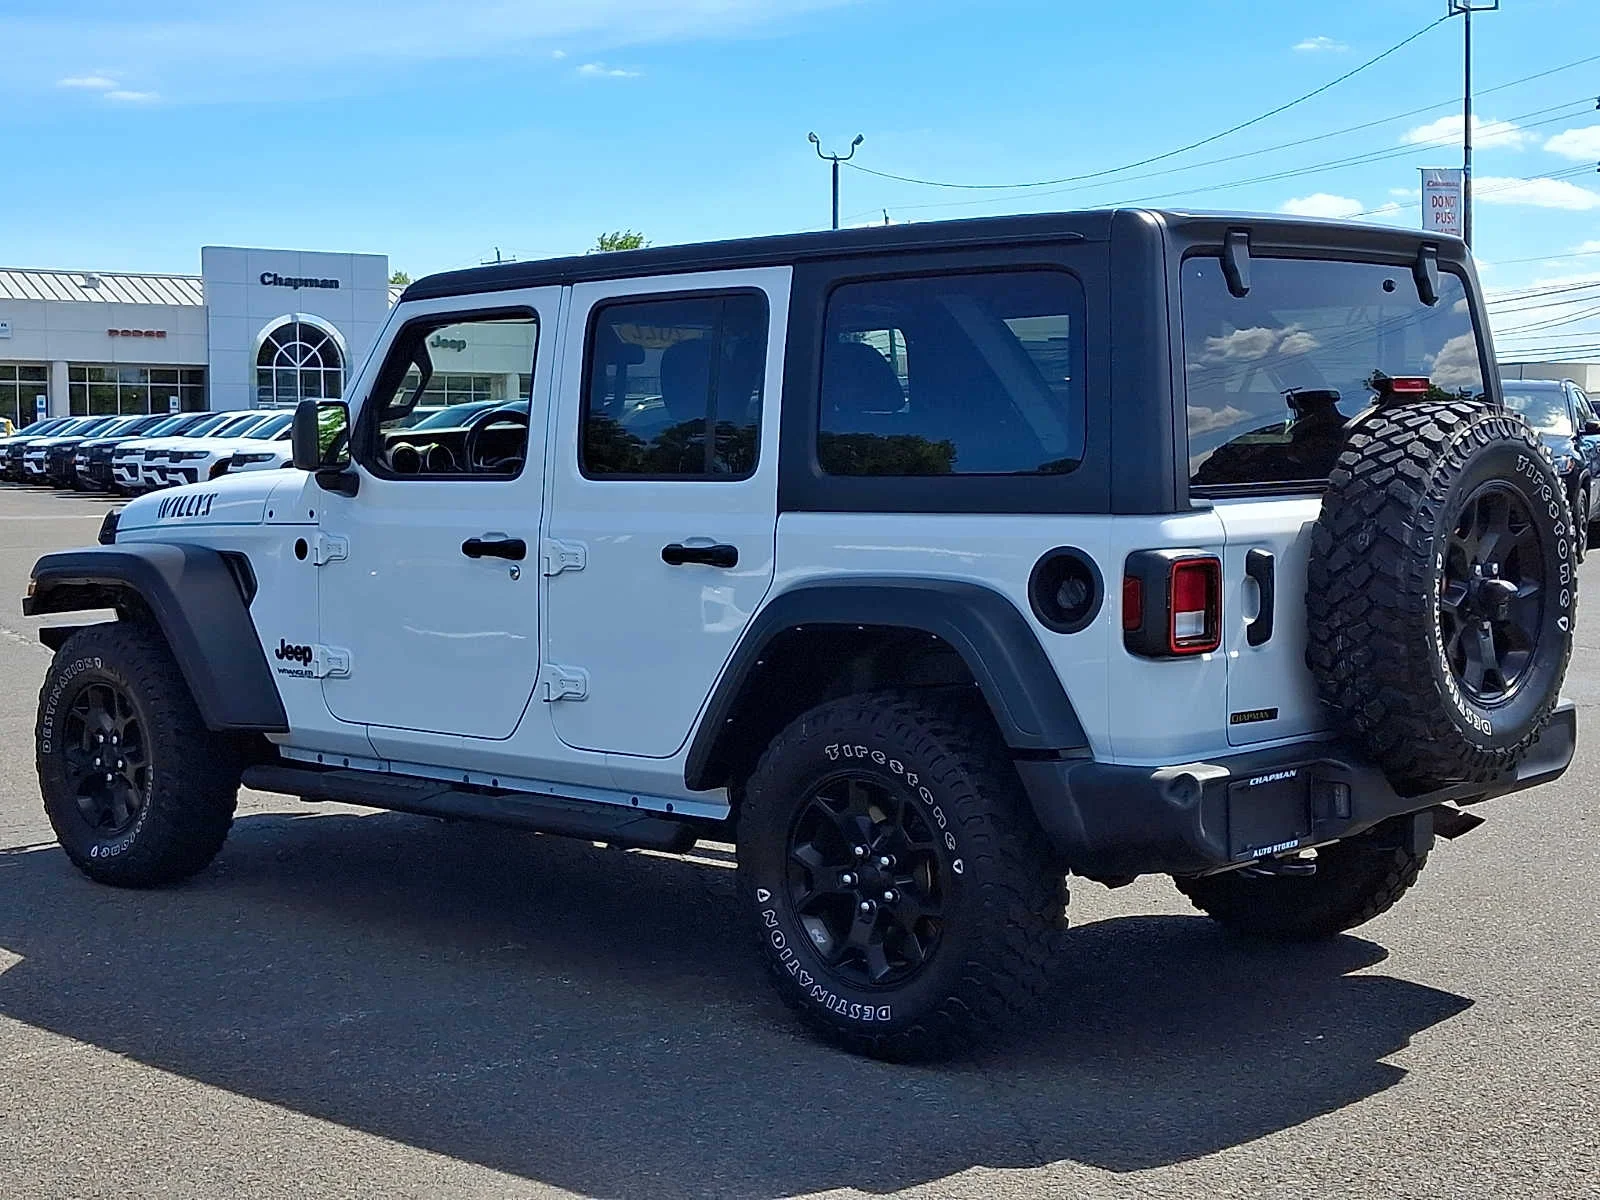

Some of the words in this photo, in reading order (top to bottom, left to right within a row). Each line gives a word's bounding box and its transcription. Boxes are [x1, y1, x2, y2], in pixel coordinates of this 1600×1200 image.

[1432, 195, 1444, 208] DO
[1445, 195, 1457, 208] NOT
[1435, 211, 1456, 224] PUSH
[260, 271, 340, 290] Chapman
[108, 328, 168, 338] DODGE
[430, 334, 467, 352] Jeep
[157, 492, 219, 519] WILLYS
[1515, 454, 1570, 608] Firestone
[275, 638, 313, 667] Jeep
[277, 668, 314, 677] WRANGLER
[42, 657, 94, 754] DESTINATION
[1231, 711, 1270, 723] CHAPMAN
[1249, 769, 1297, 786] CHAPMAN
[824, 744, 957, 851] Firestone
[1252, 845, 1272, 858] AUTO
[1273, 839, 1299, 854] STORES
[762, 910, 891, 1021] DESTINATION
